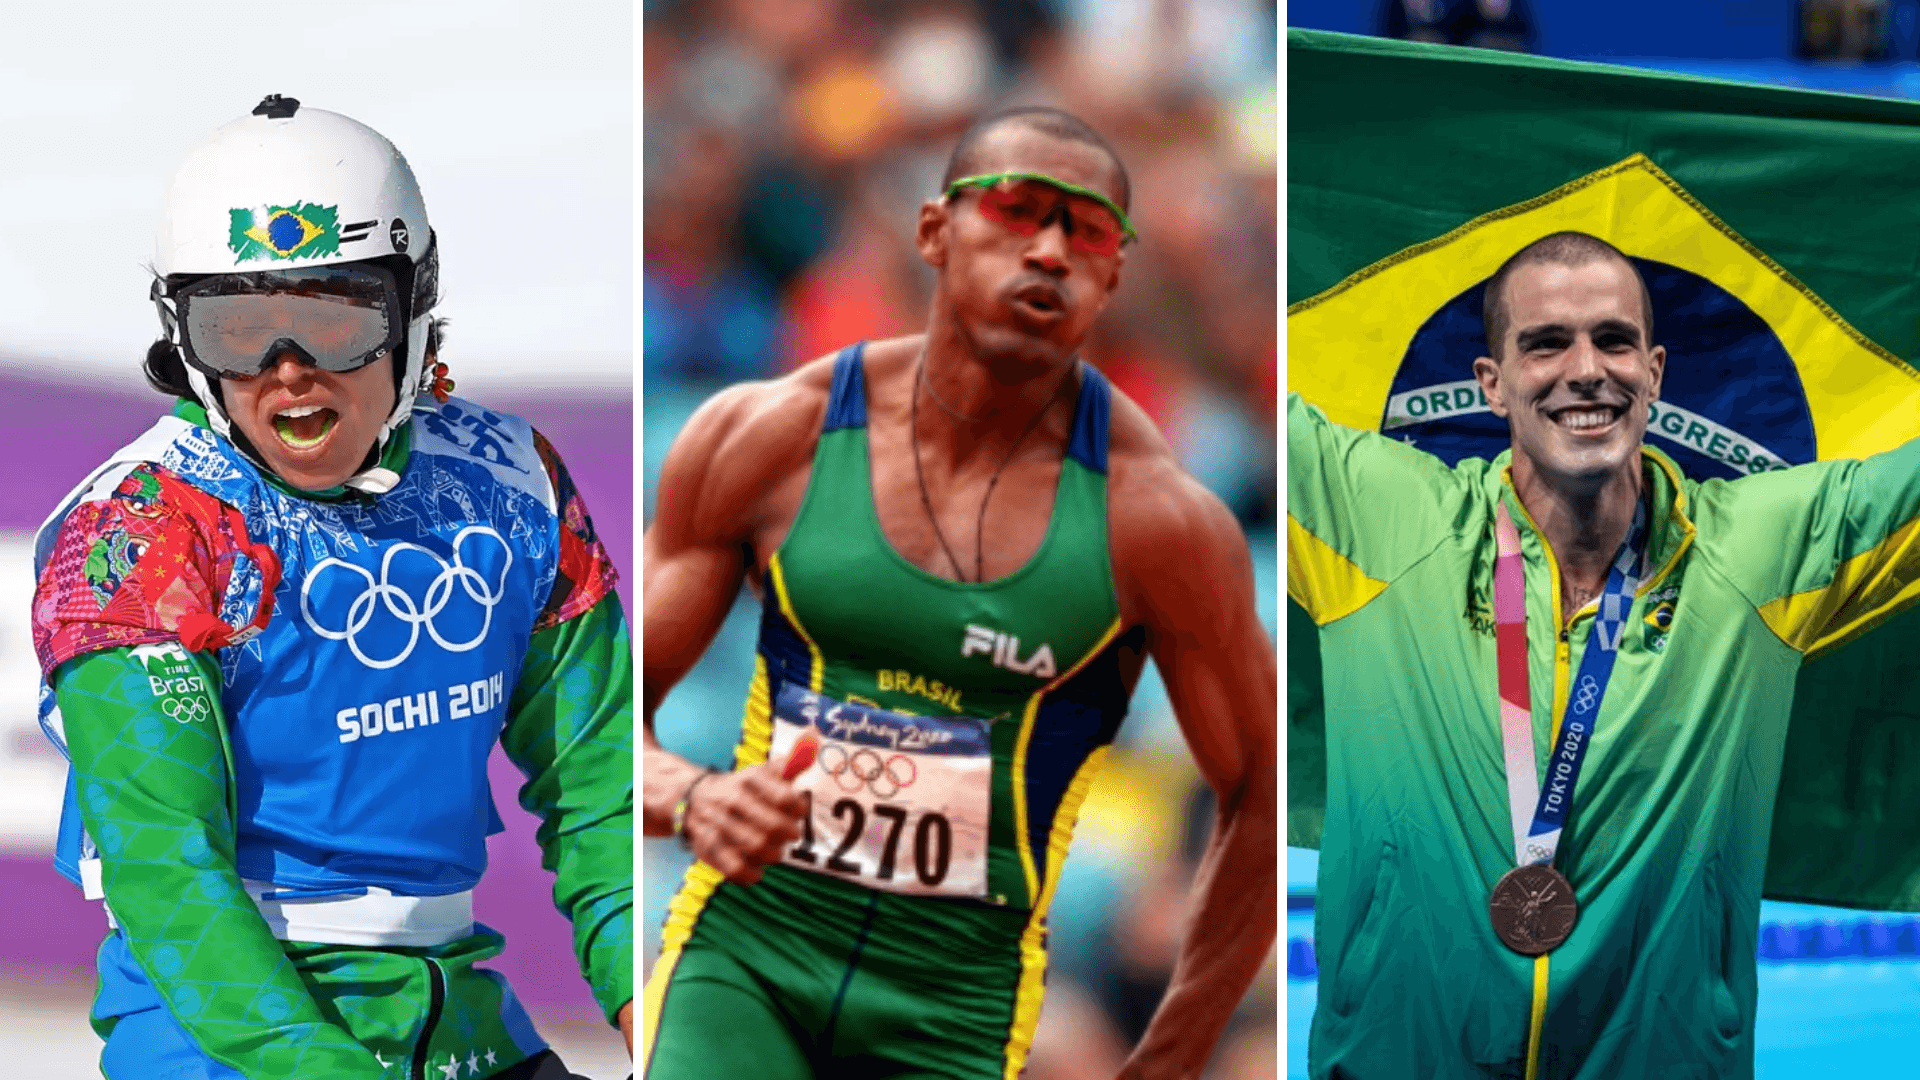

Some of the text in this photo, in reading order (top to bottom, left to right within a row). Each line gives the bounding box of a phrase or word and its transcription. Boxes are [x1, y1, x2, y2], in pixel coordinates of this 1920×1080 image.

[1406, 387, 1488, 417] ORD
[164, 665, 191, 676] TIME
[962, 623, 1057, 679] FILA
[336, 671, 504, 744] SOCHI 2014
[877, 669, 963, 713] BRASIL
[825, 706, 899, 749] Sydney
[1544, 722, 1586, 814] TOKYO 2020
[790, 790, 953, 887] 1270
